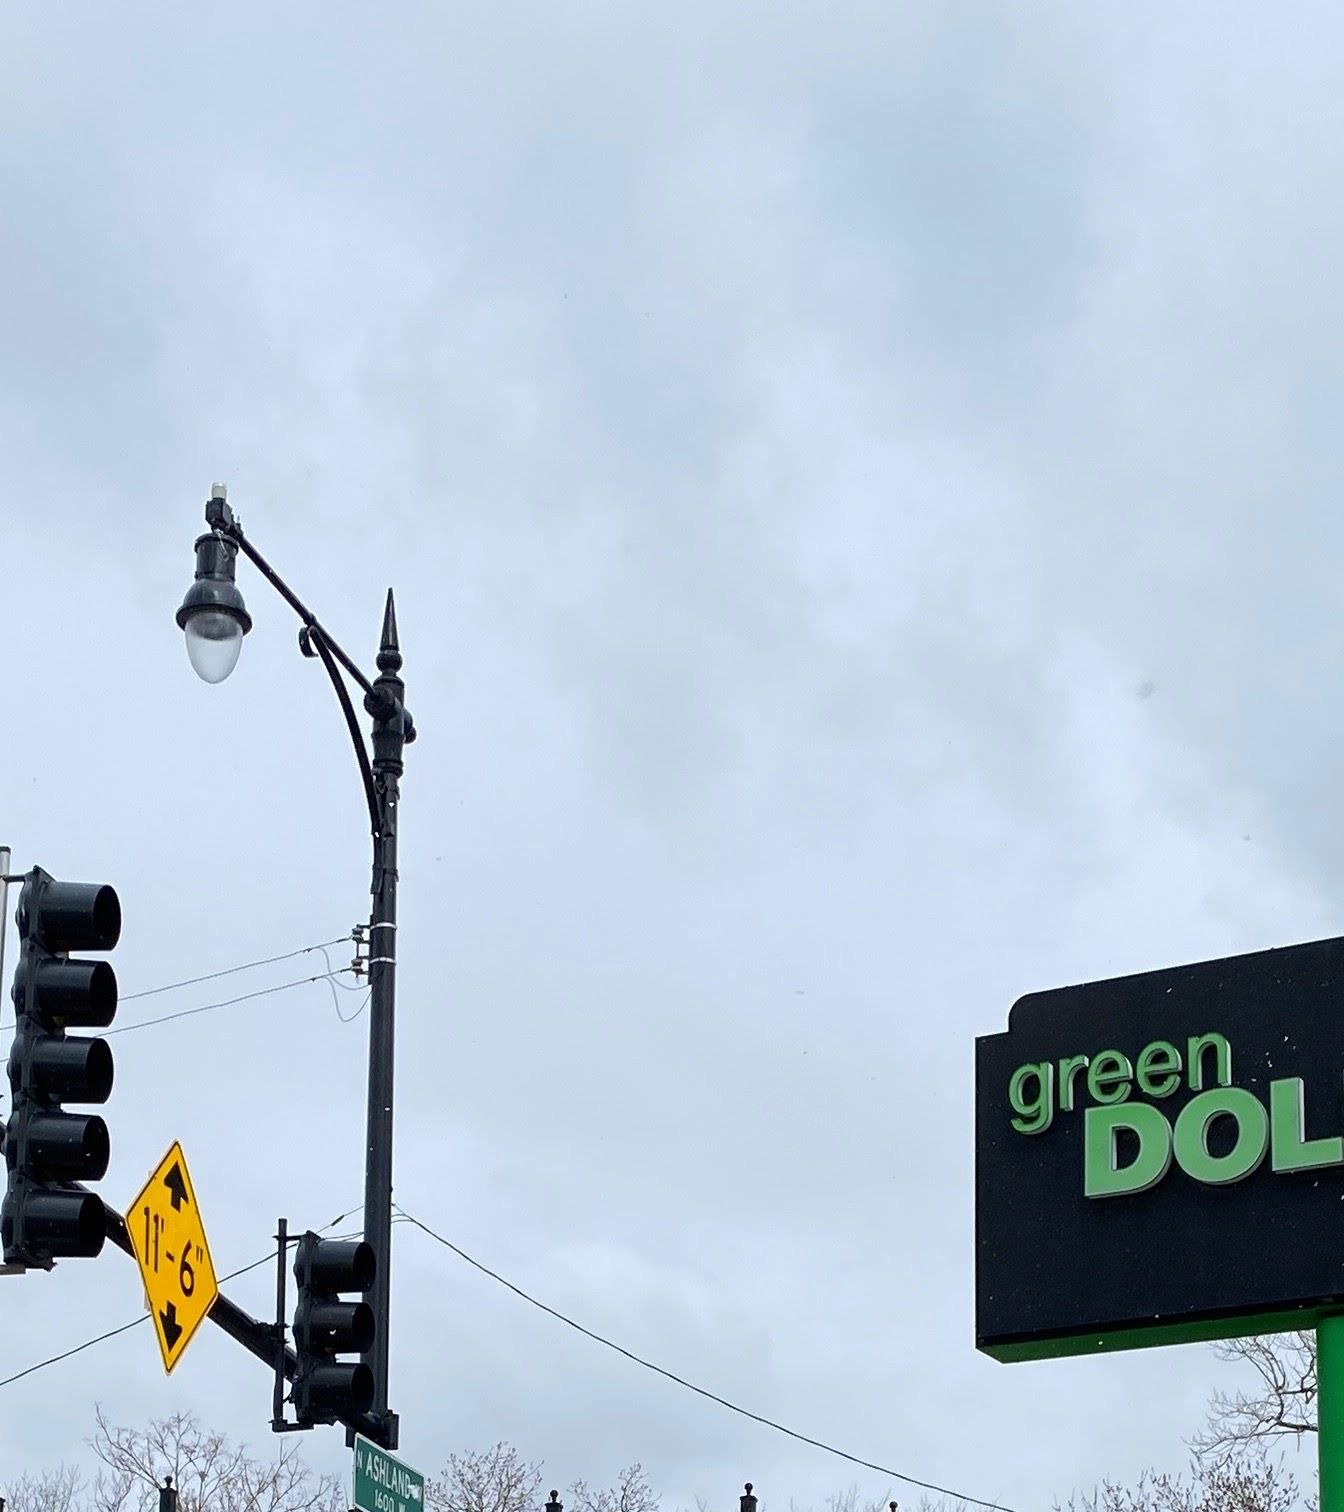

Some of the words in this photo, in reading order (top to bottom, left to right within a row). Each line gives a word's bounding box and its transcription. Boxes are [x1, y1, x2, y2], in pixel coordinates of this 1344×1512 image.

[1008, 1031, 1232, 1136] green
[357, 1449, 363, 1469] N
[365, 1451, 411, 1499] ASHLAND
